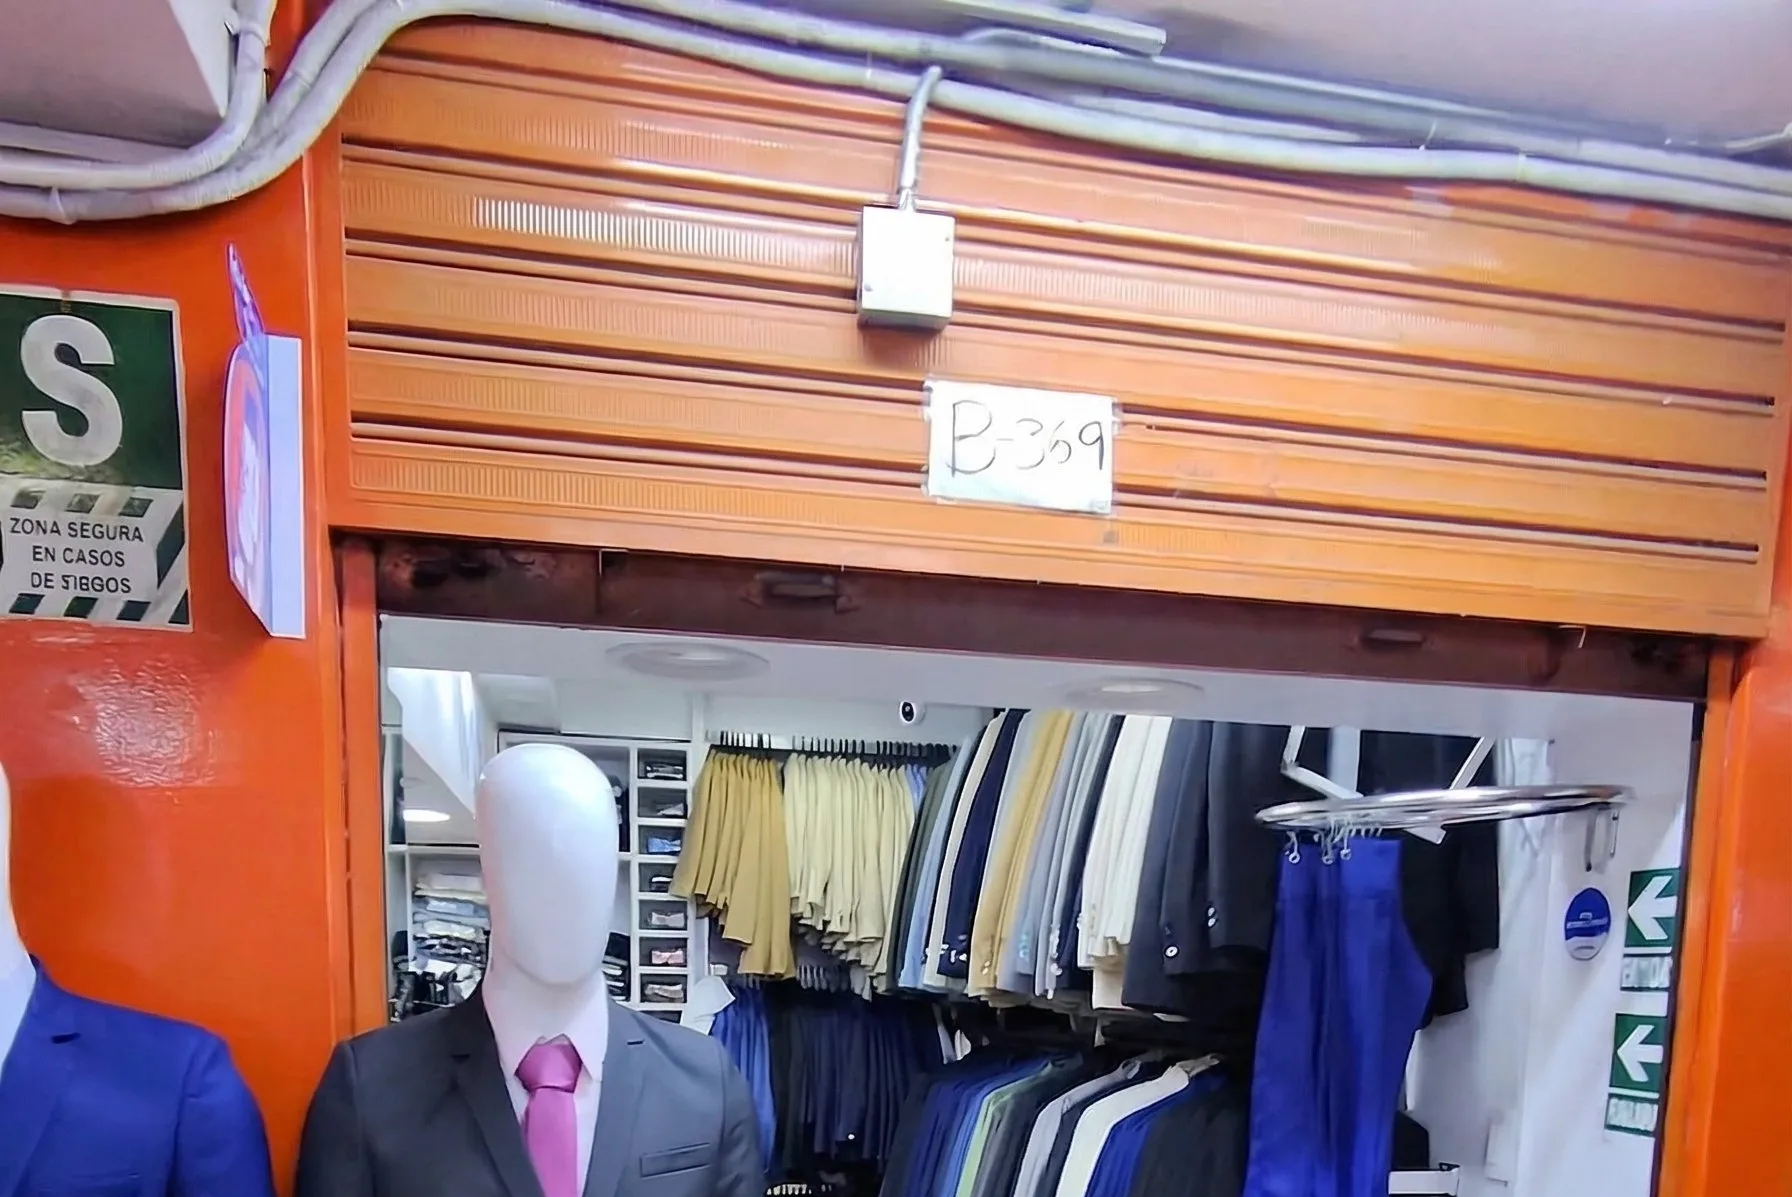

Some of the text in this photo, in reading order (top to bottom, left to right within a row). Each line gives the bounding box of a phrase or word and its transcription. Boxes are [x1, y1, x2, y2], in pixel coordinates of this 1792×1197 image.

[20, 315, 123, 467] S
[946, 399, 1105, 478] B-369
[10, 517, 144, 542] ZONA SEGURA
[32, 545, 125, 567] EN CASOS
[30, 572, 55, 589] DE
